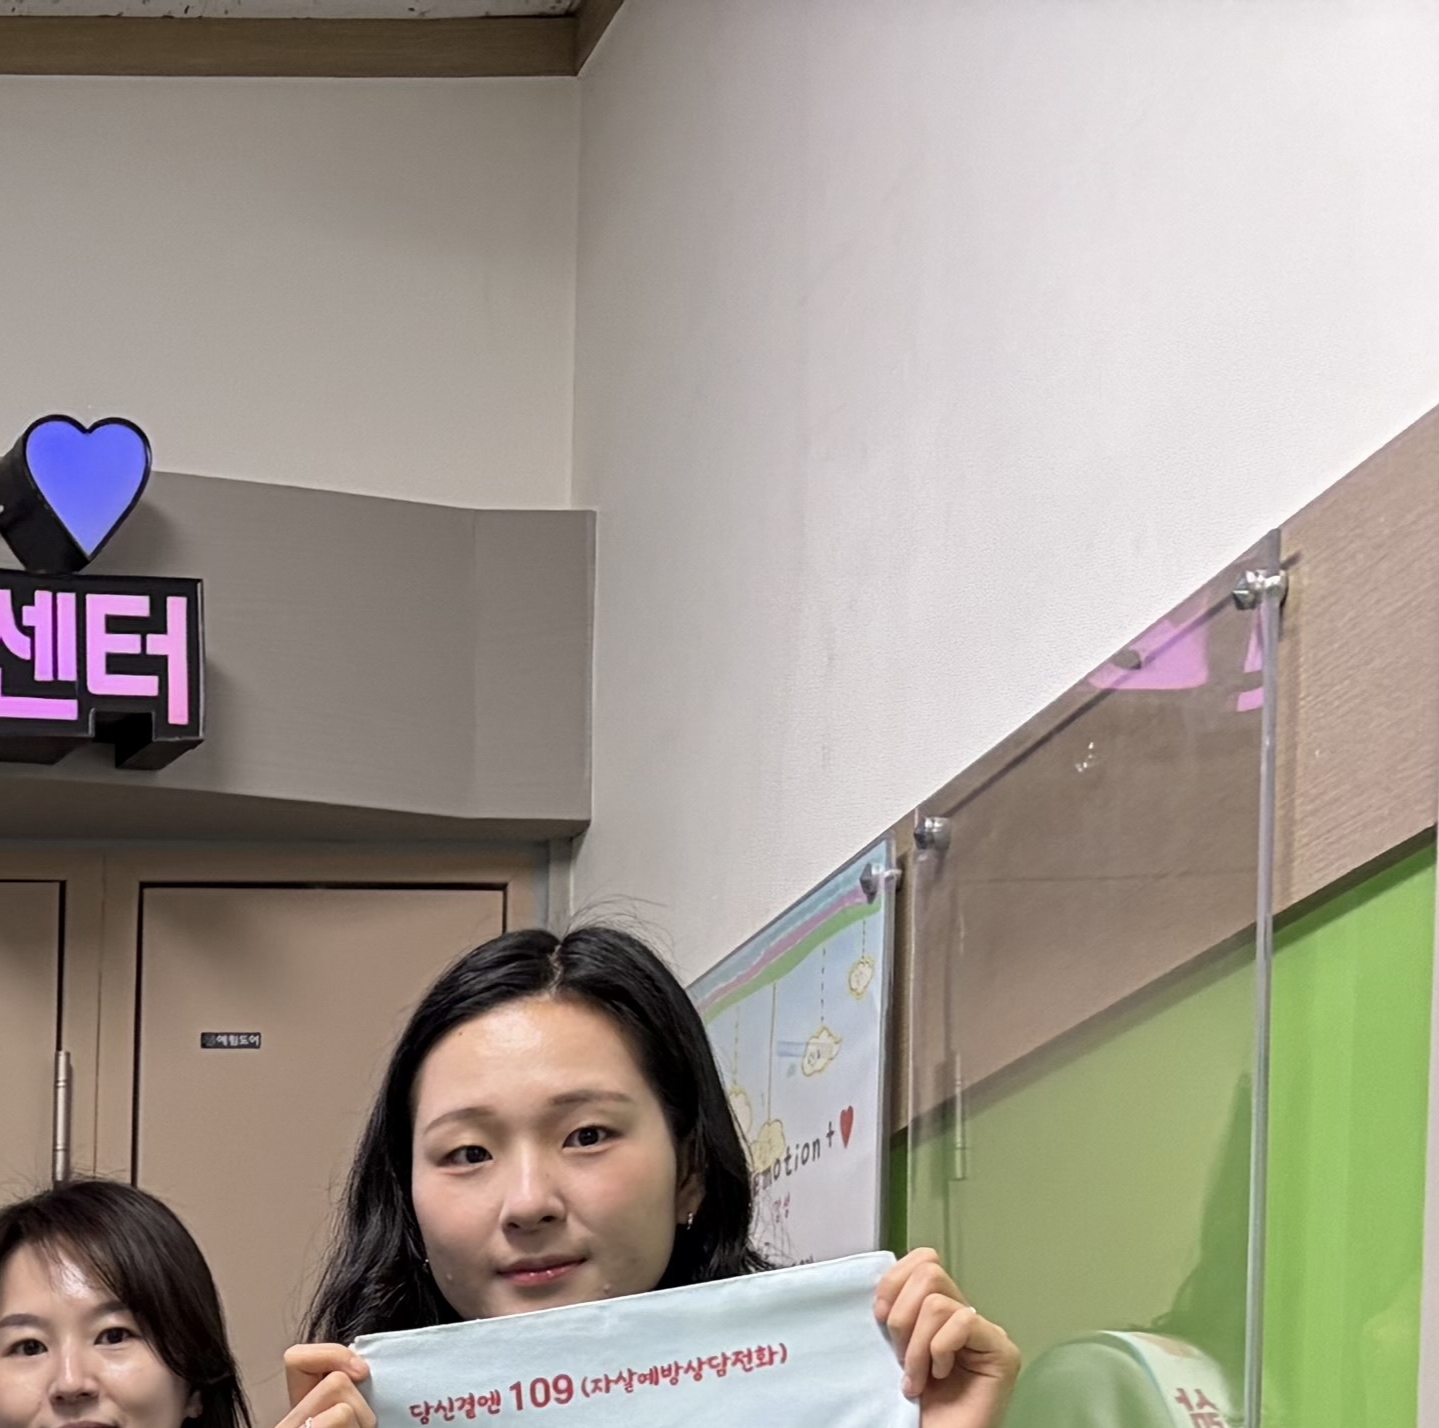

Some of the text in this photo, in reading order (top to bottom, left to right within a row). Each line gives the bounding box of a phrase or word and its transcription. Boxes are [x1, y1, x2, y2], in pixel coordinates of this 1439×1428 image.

[409, 1342, 789, 1425] 당신곁엔 109 (자살예방상담전화)
